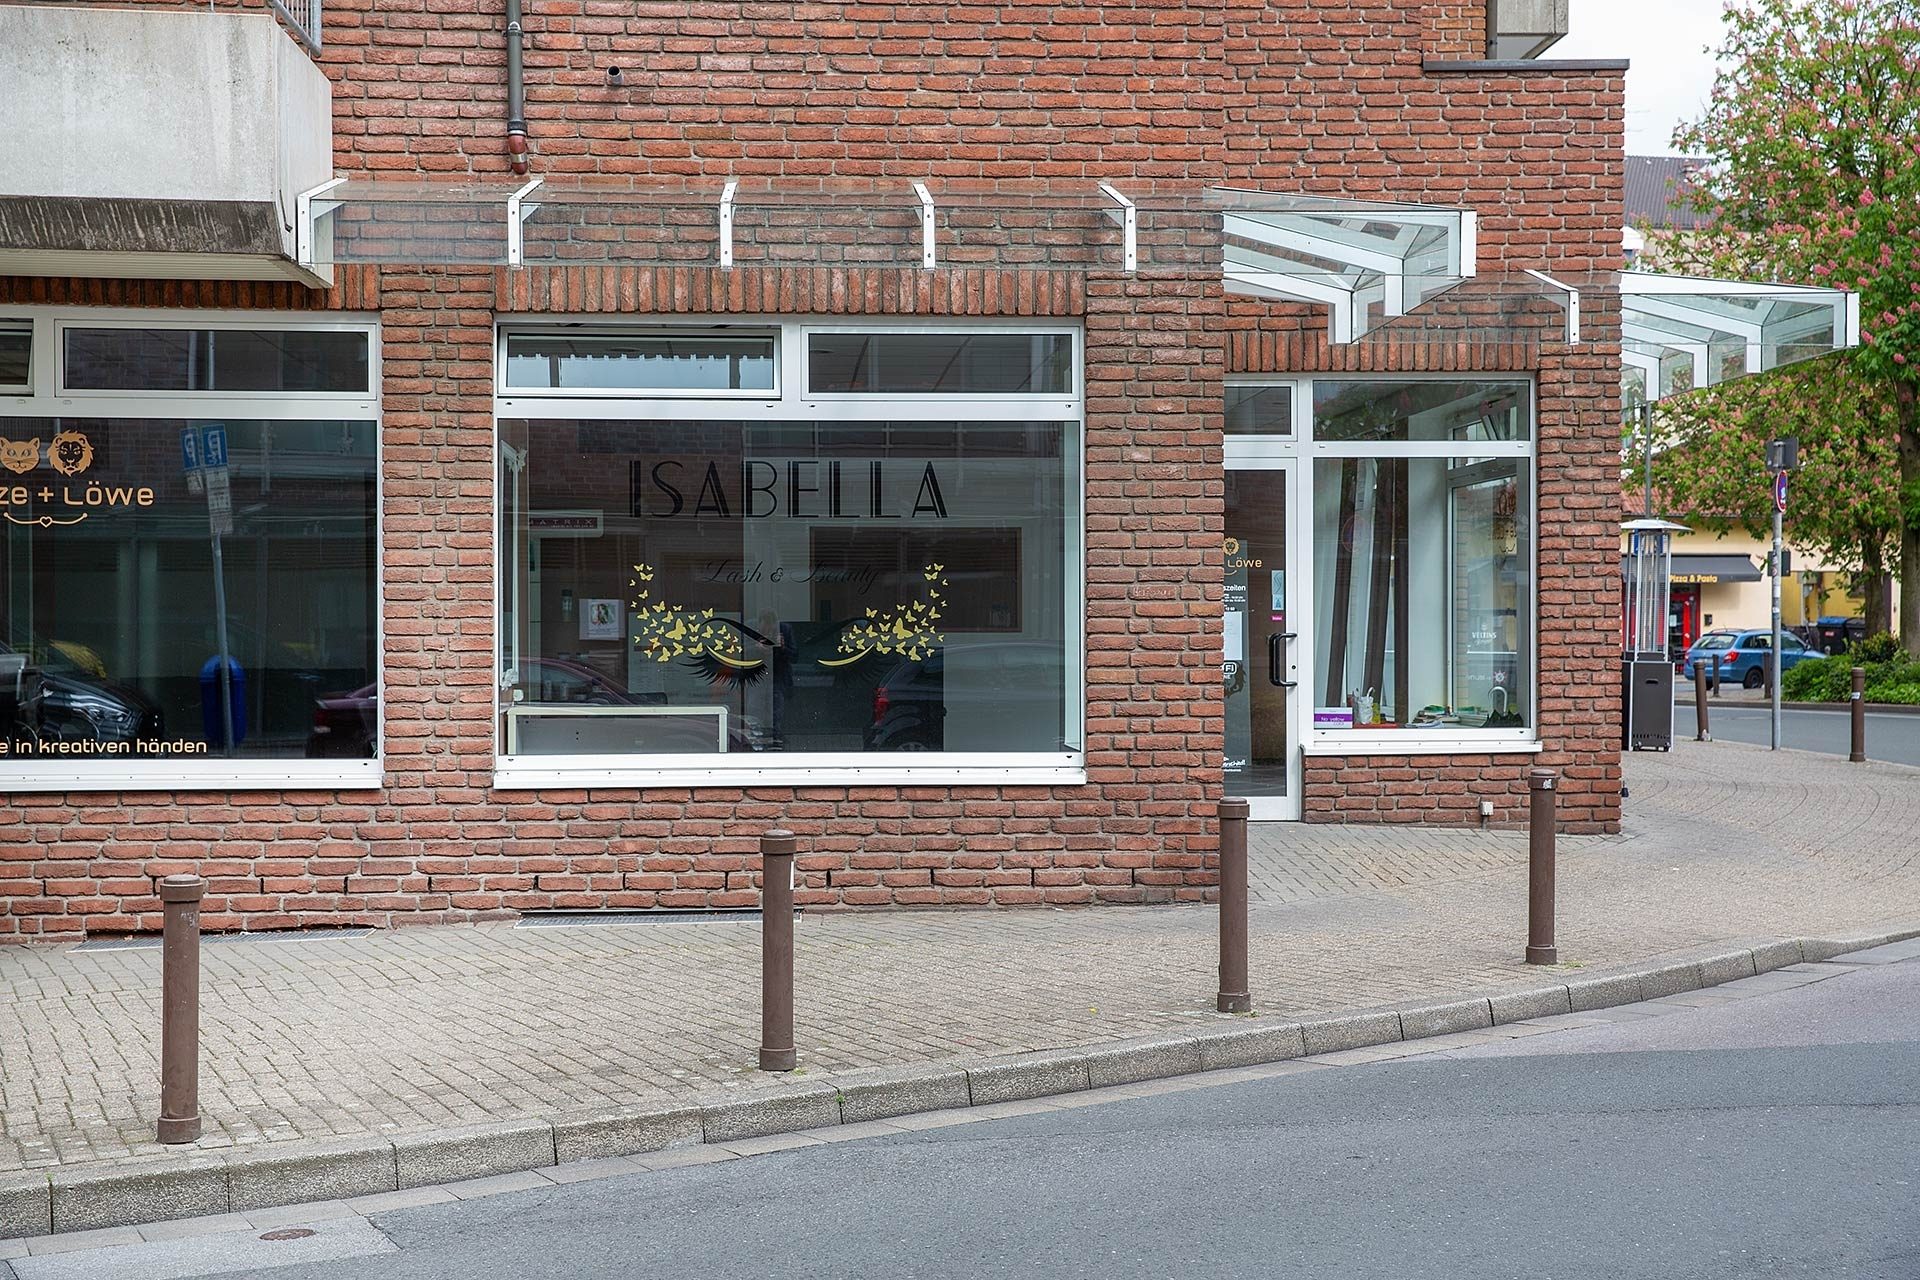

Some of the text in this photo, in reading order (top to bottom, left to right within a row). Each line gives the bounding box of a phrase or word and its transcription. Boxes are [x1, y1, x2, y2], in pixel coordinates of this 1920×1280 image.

[64, 481, 154, 506] Löwe
[628, 460, 948, 518] ISABELLA
[1227, 556, 1263, 568] Löwe
[702, 559, 881, 595] Lash & Beauty
[1696, 574, 1718, 583] Pasta
[15, 738, 32, 754] in
[39, 738, 130, 754] kreativen
[136, 738, 207, 754] händen
